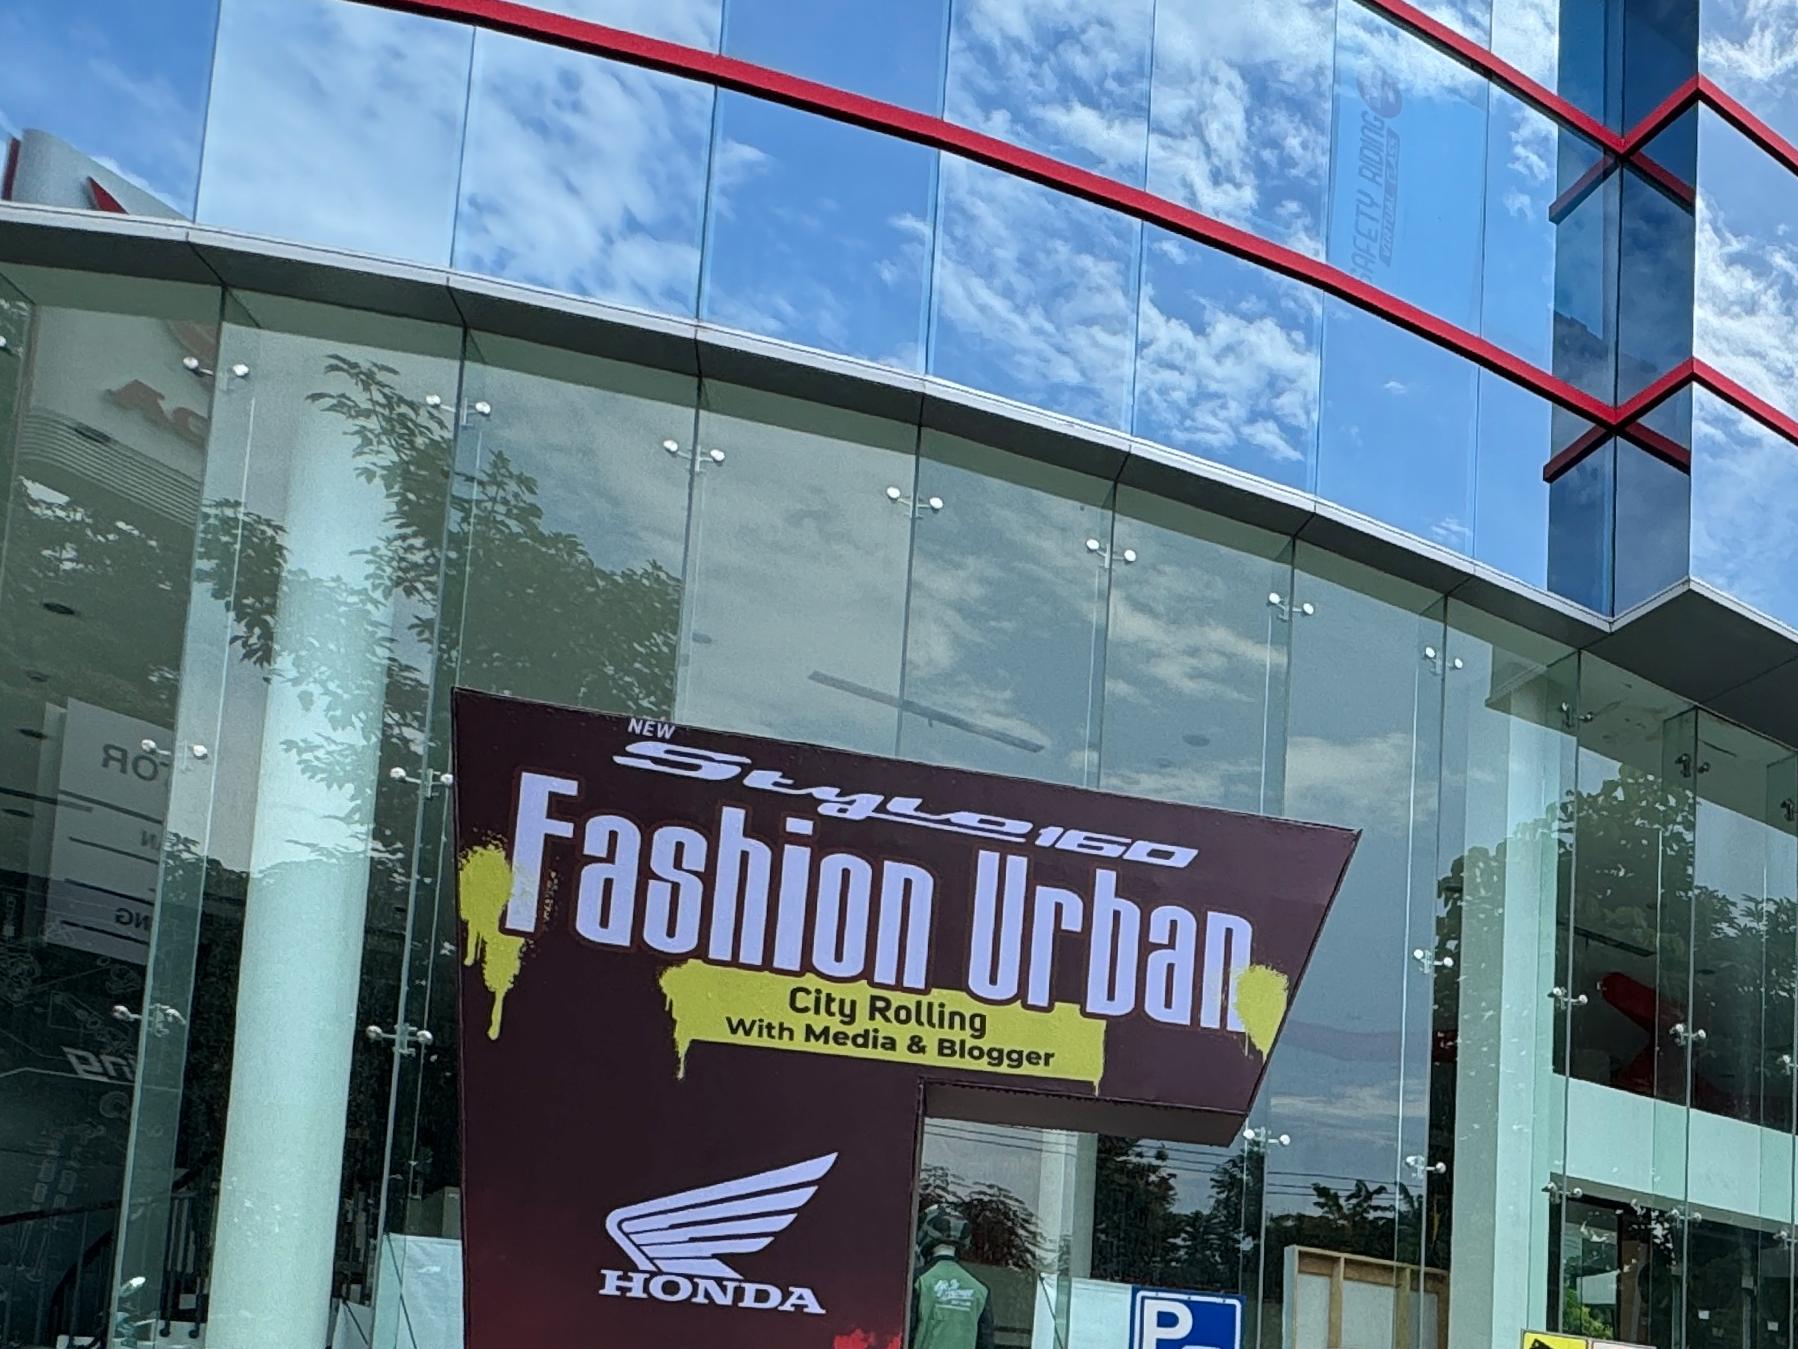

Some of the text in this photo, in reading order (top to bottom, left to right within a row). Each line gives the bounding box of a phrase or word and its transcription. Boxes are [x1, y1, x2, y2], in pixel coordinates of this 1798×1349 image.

[1358, 110, 1385, 187] RIDING
[628, 718, 675, 739] NEW
[505, 771, 1253, 1033] Fashion Urban
[788, 986, 987, 1039] City Rolling
[725, 1016, 1056, 1068] With Media & Blogger
[599, 1269, 827, 1315] HONDA
